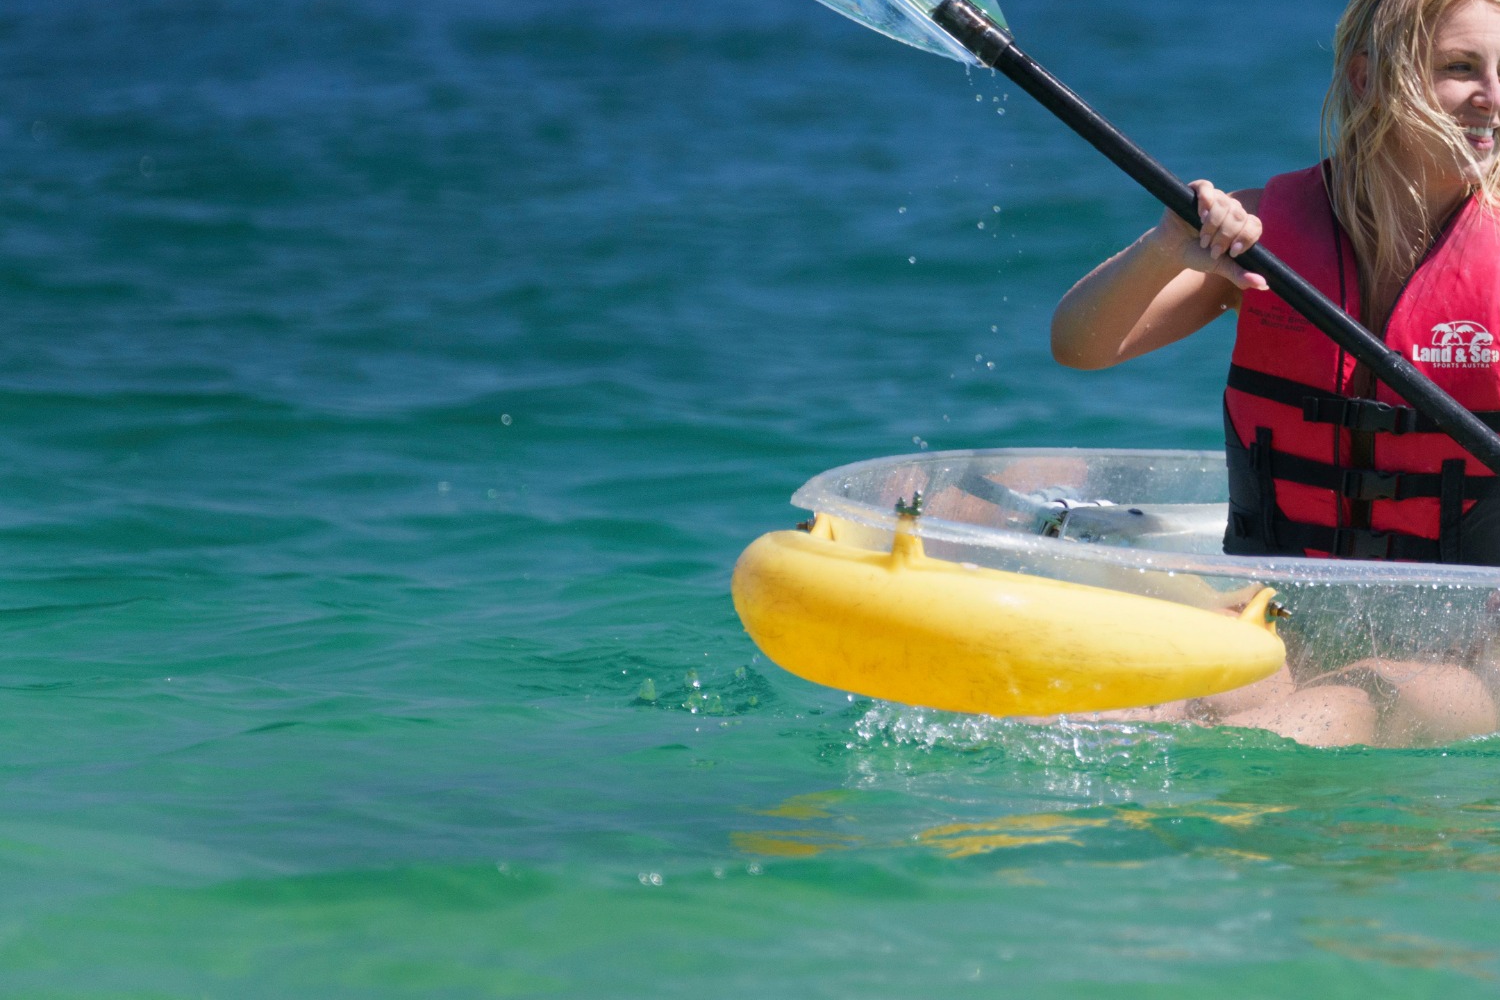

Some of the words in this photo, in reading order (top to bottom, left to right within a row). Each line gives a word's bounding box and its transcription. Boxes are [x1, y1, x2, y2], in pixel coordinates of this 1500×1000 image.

[1412, 344, 1451, 362] Land
[1455, 349, 1468, 362] &
[1471, 345, 1500, 363] Sea
